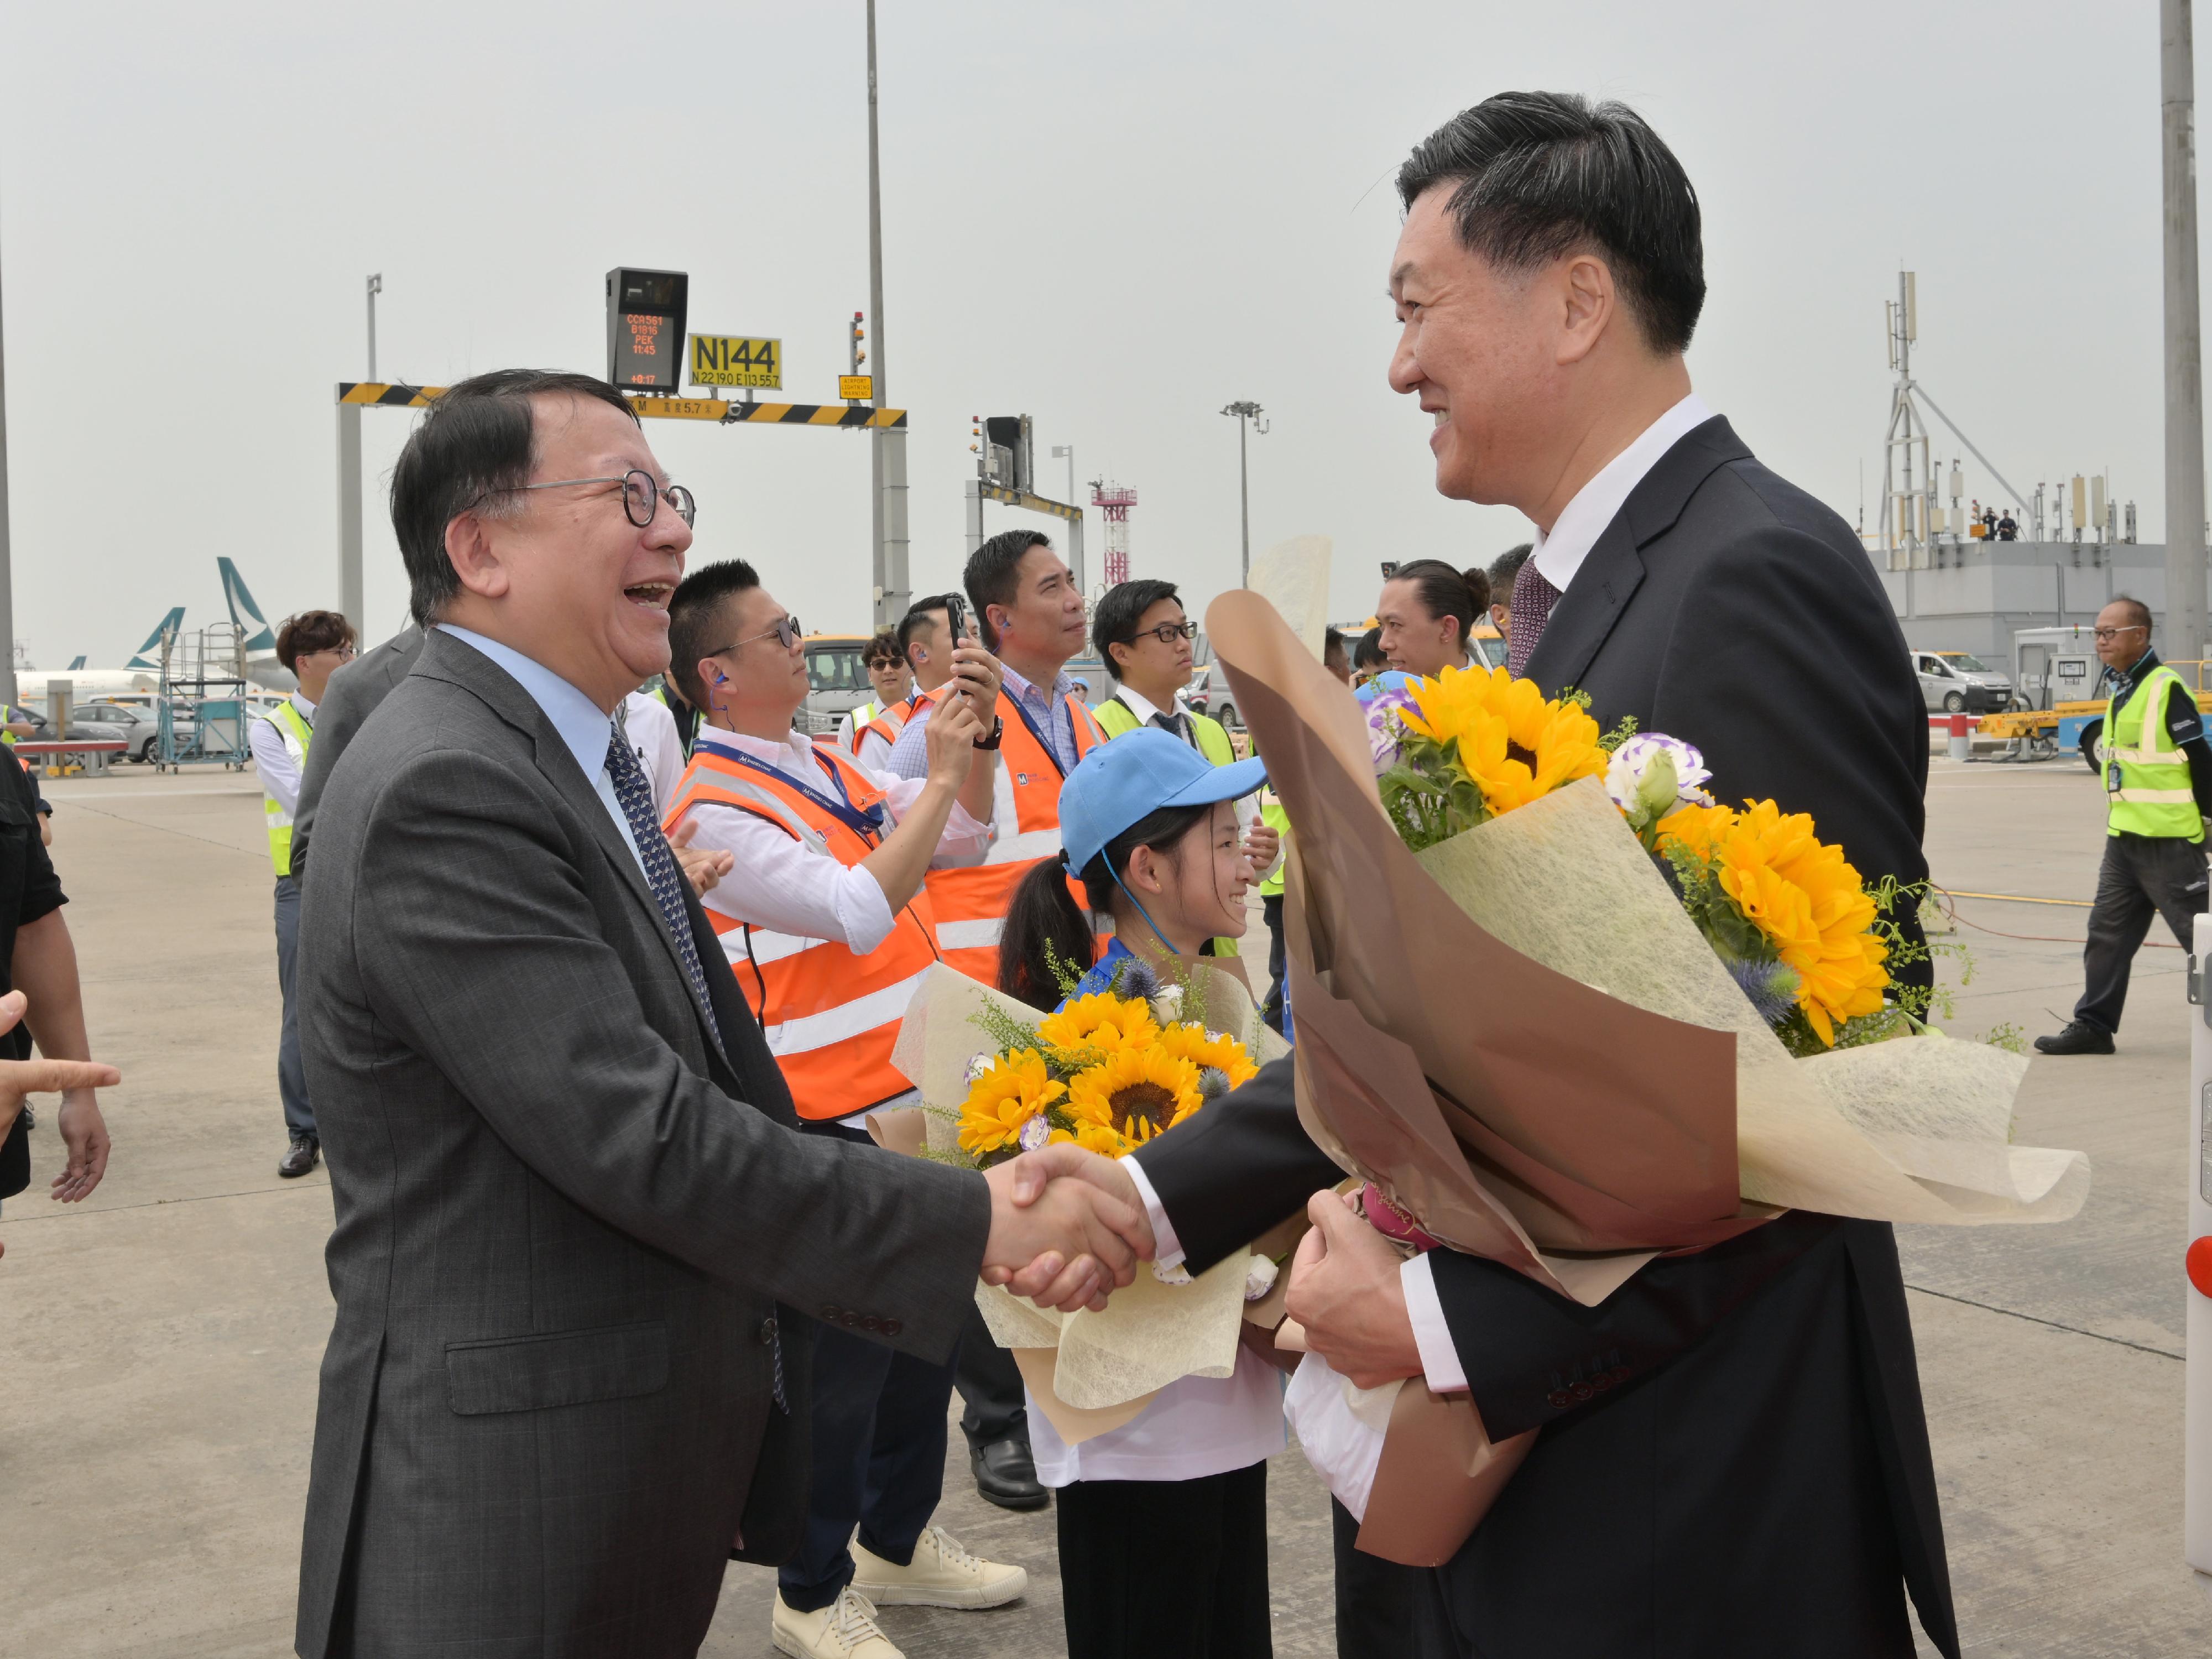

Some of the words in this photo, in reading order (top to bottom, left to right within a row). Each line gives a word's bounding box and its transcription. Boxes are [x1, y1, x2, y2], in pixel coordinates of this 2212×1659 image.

[627, 314, 662, 326] CCA561
[635, 335, 653, 345] PEK
[633, 345, 656, 355] 11:45
[697, 338, 775, 373] N144
[692, 372, 699, 383] N
[701, 372, 714, 384] 22
[717, 373, 733, 385] 19.0
[737, 374, 742, 385] E
[745, 374, 757, 387] 113
[760, 375, 779, 388] 55.7
